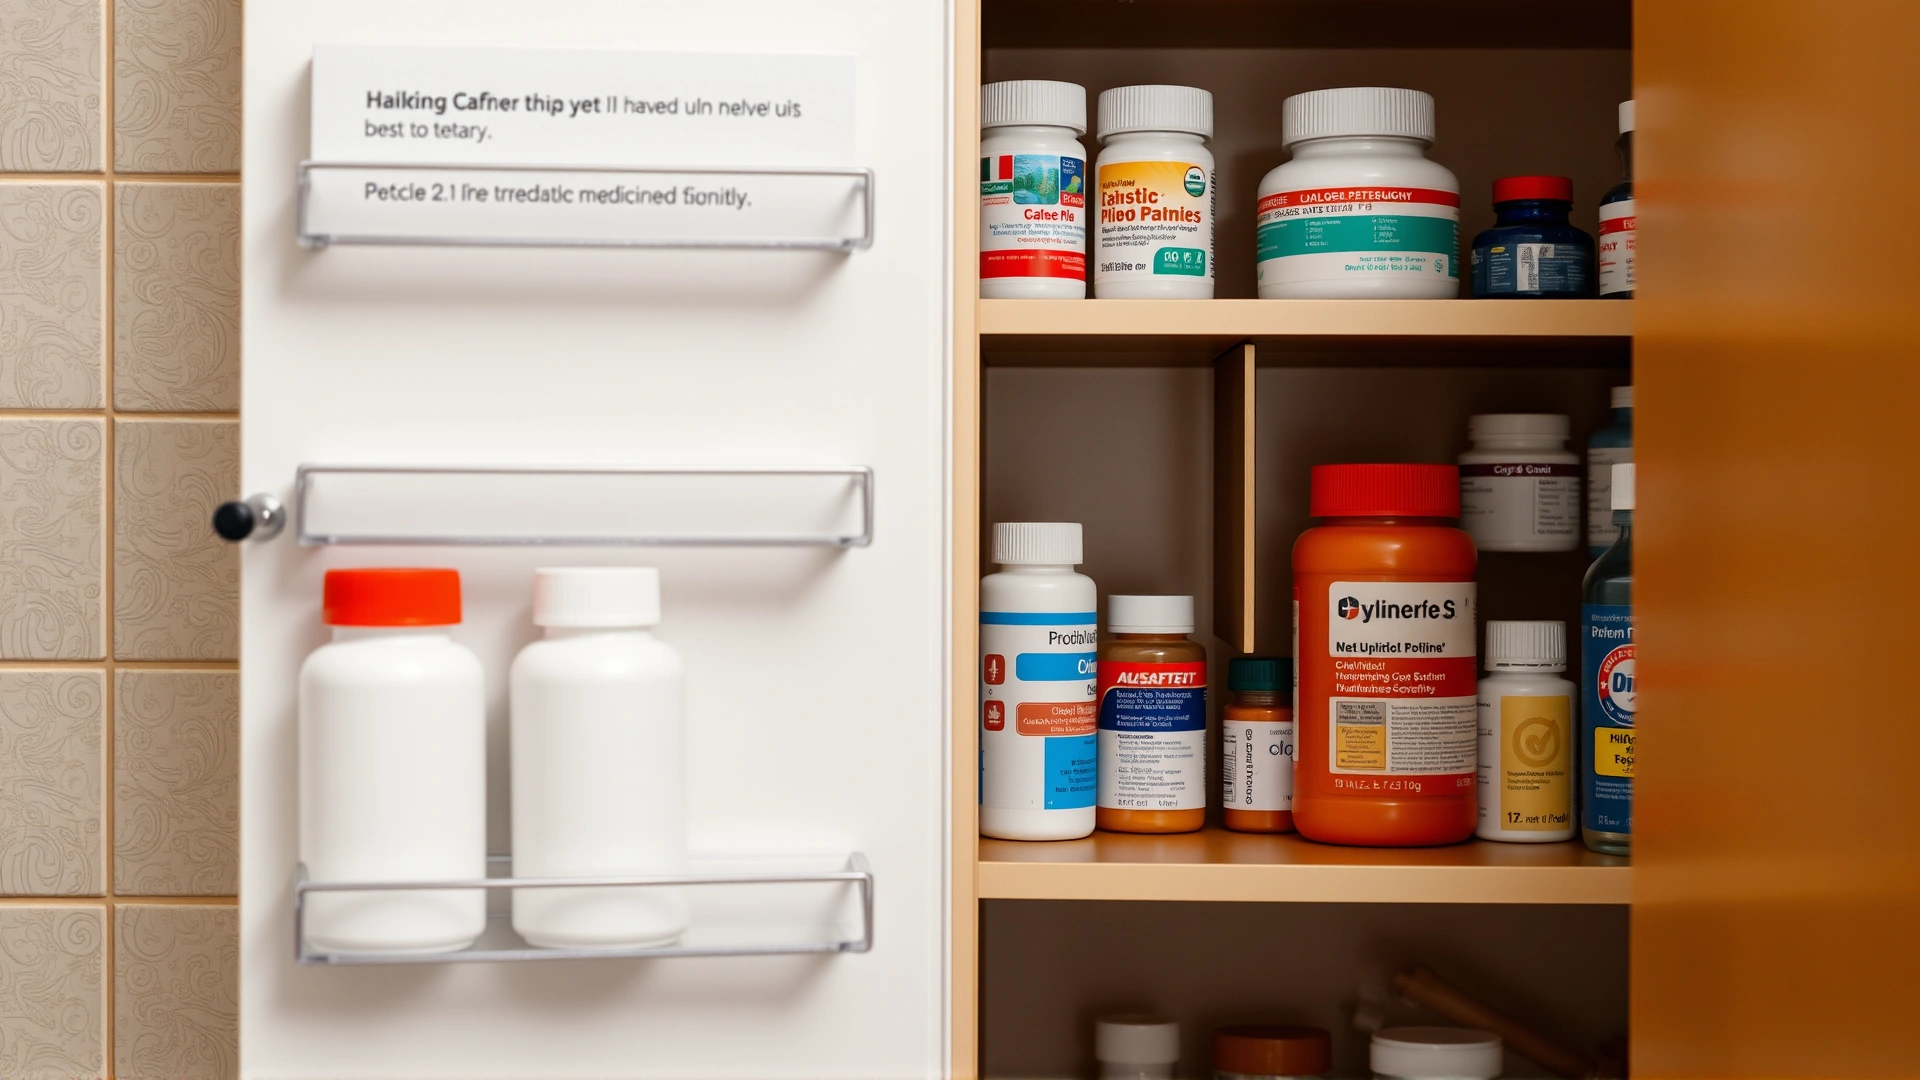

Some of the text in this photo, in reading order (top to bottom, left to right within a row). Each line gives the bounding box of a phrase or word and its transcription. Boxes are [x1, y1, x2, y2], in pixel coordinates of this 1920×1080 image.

[569, 97, 601, 119] yet
[624, 96, 678, 115] haved
[364, 118, 404, 138] best
[409, 122, 429, 138] to
[579, 185, 677, 205] medicined
